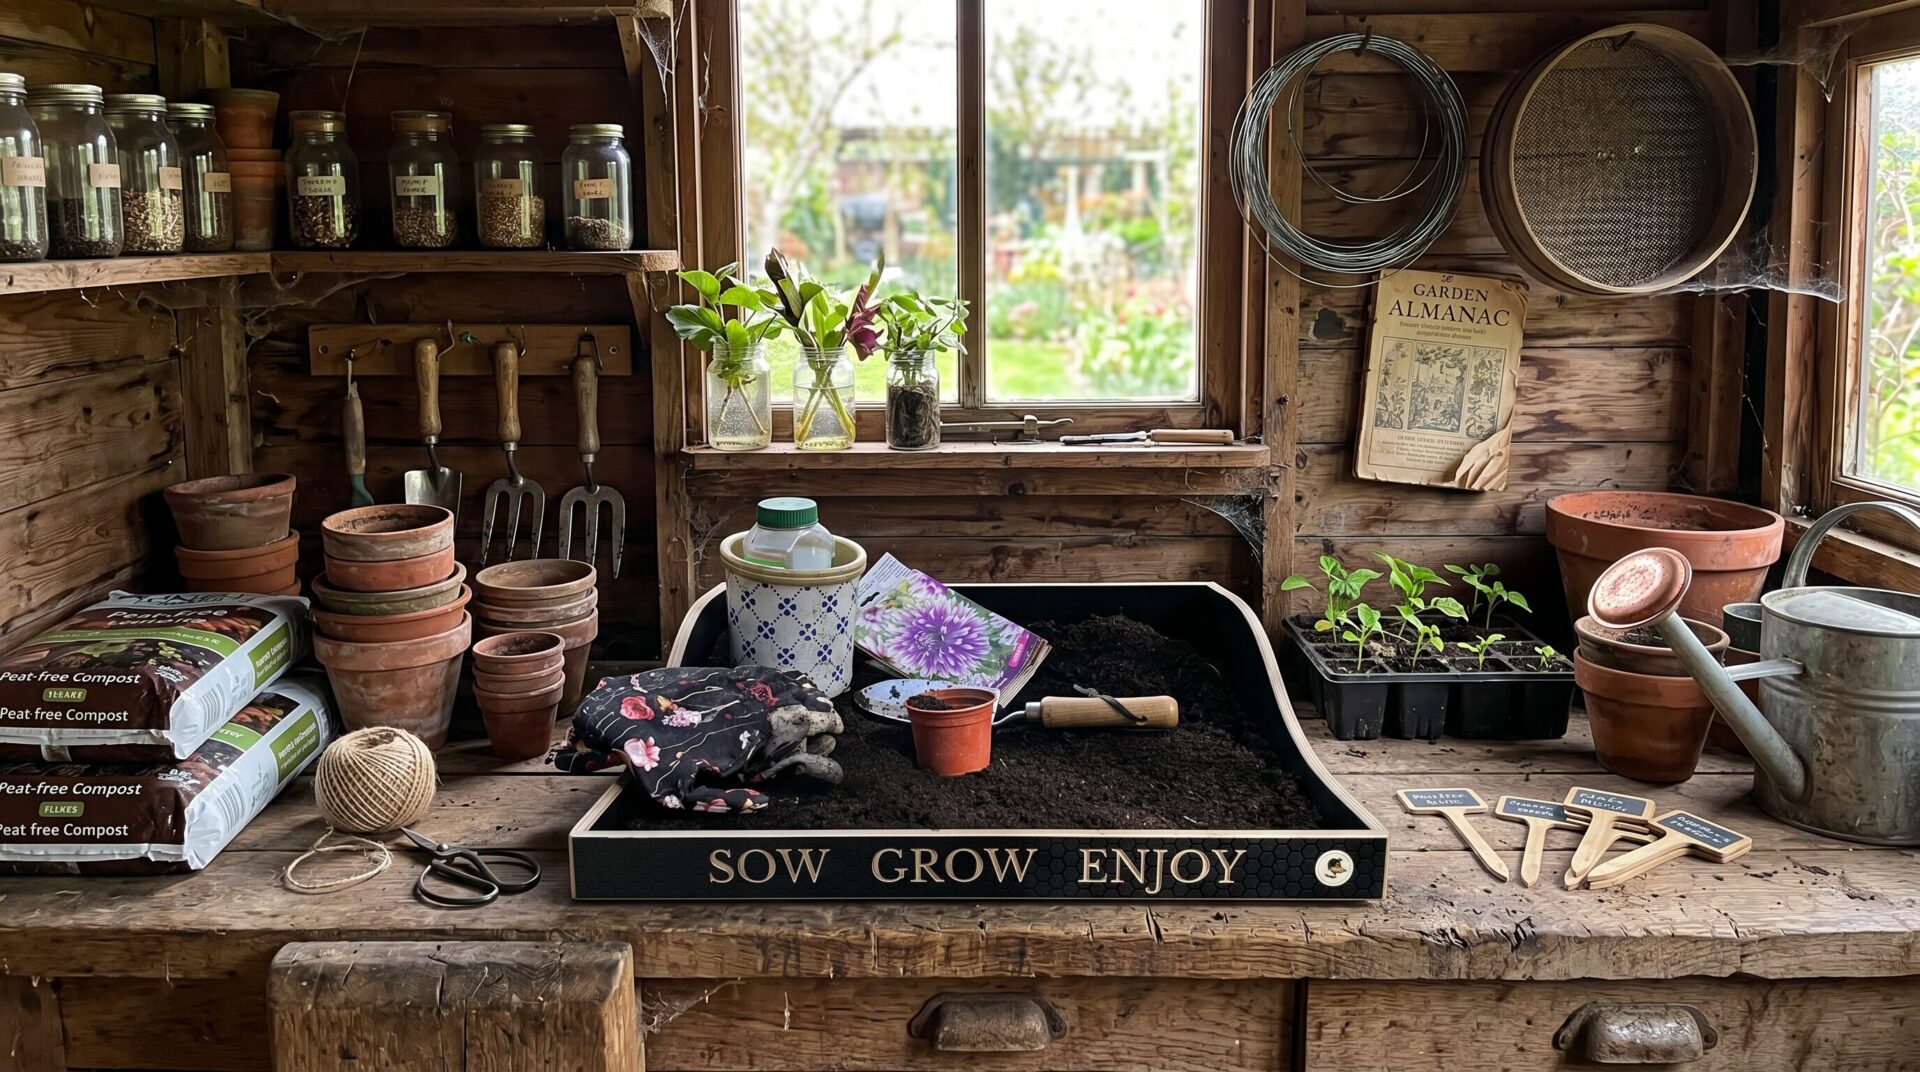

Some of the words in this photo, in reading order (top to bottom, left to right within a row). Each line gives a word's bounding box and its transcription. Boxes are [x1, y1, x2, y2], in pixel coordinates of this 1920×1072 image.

[1413, 283, 1489, 302] GARDEN
[1388, 299, 1510, 327] ALMANAC
[0, 671, 69, 682] Peat-free
[72, 672, 141, 685] Compost
[66, 708, 128, 723] Compost
[0, 781, 69, 795] Peat-free
[72, 783, 142, 798] Compost
[30, 822, 60, 836] free
[63, 823, 129, 839] Compost
[709, 848, 831, 884] SOW
[871, 848, 1038, 884] GROW
[1078, 848, 1247, 894] ENJOY
